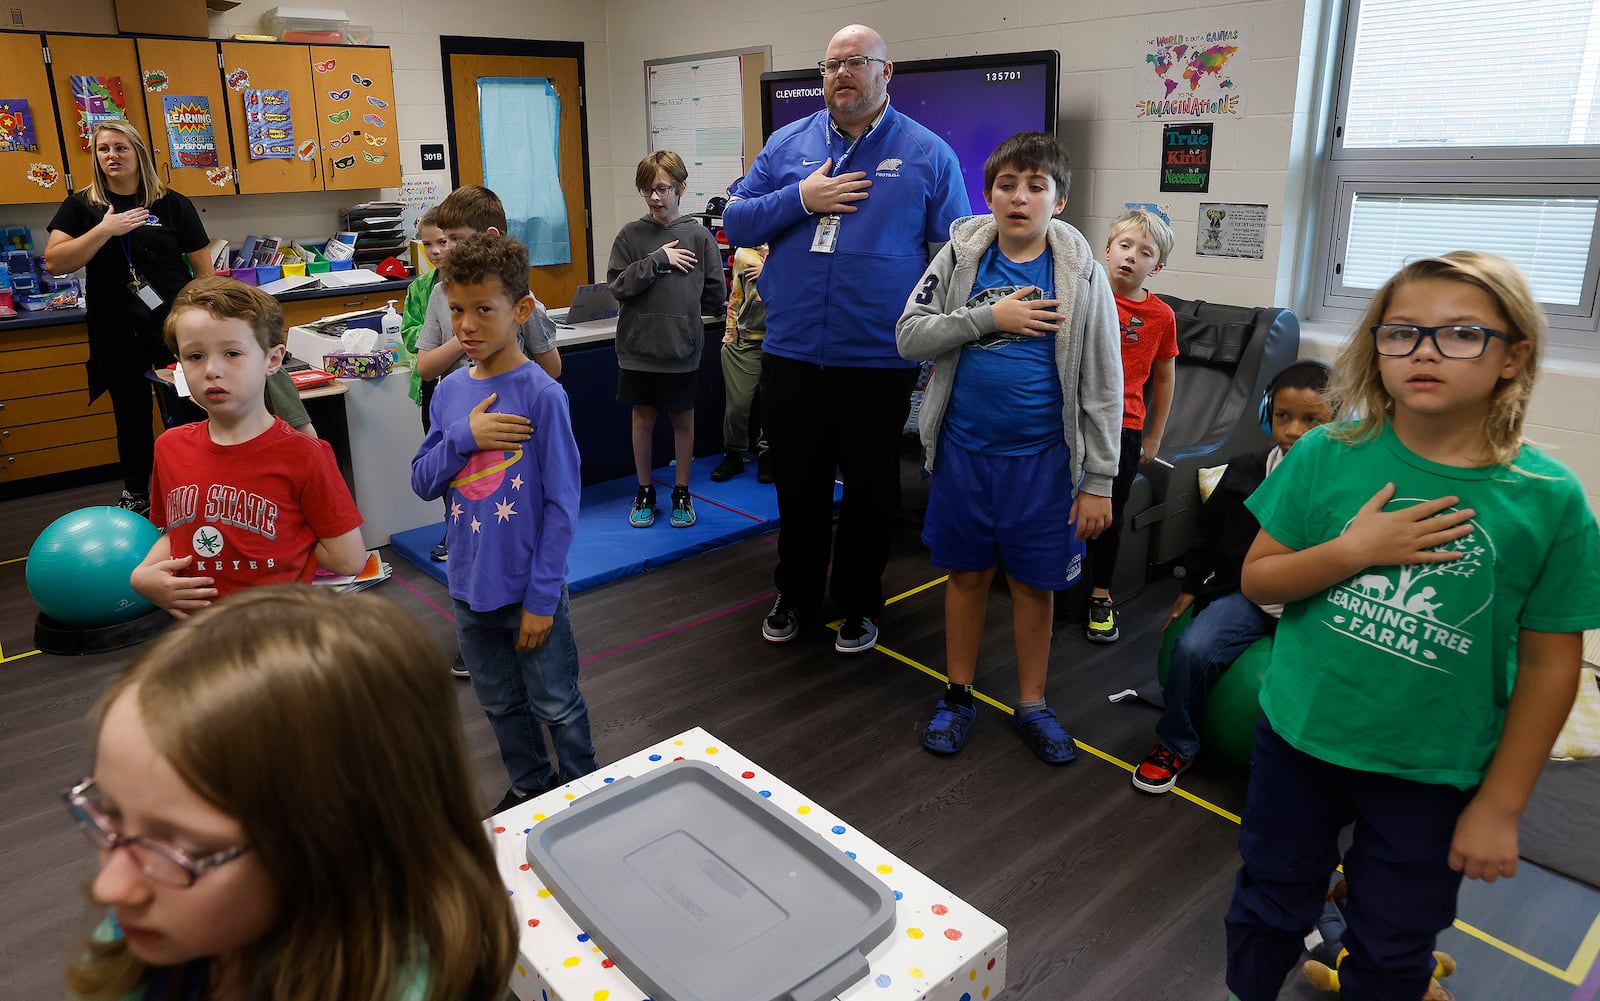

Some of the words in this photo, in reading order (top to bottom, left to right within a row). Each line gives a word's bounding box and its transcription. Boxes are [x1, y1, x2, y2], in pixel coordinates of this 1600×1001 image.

[1156, 34, 1183, 47] WORLD
[1206, 30, 1238, 42] CANVAS
[986, 71, 1021, 81] 135701
[776, 87, 825, 98] CLEVERTOUCH
[167, 113, 212, 123] LEARNING
[1167, 131, 1209, 146] True
[173, 143, 215, 151] SUPERPOWER
[423, 153, 442, 161] 301B
[1167, 149, 1207, 165] Kind
[1164, 169, 1207, 188] Necessary
[914, 274, 940, 306] 3
[205, 484, 278, 540] STATE
[197, 557, 275, 571] KEYES
[1327, 588, 1418, 634] LEARNING
[1423, 622, 1473, 655] TREE
[1349, 616, 1419, 656] FARM
